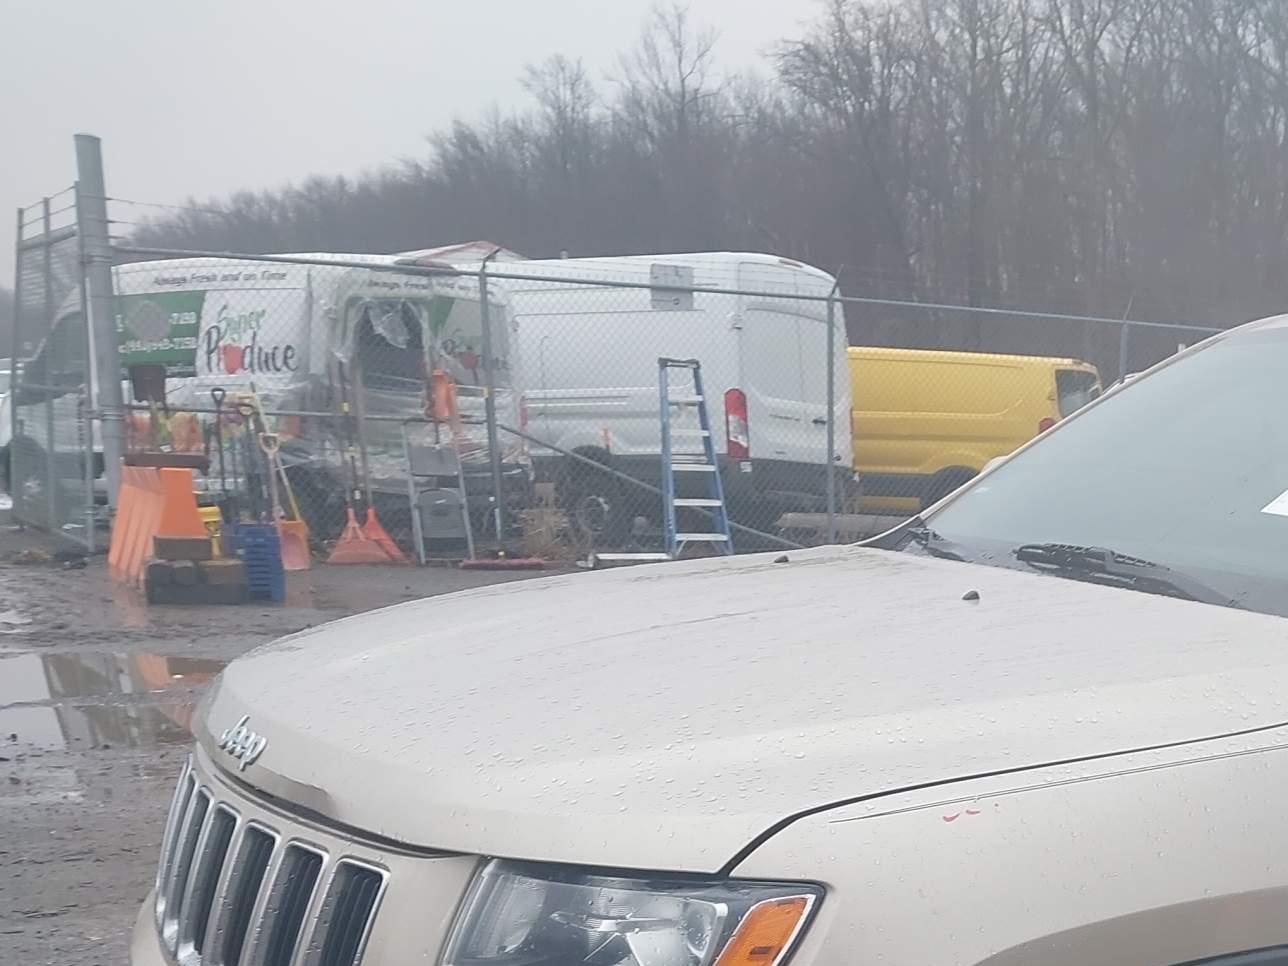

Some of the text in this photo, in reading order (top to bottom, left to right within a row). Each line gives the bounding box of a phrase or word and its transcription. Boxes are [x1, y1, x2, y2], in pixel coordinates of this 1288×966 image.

[191, 272, 217, 283] Fresh
[220, 271, 241, 281] and
[243, 273, 257, 281] on
[260, 270, 287, 281] Time
[219, 714, 268, 771] Jeep
